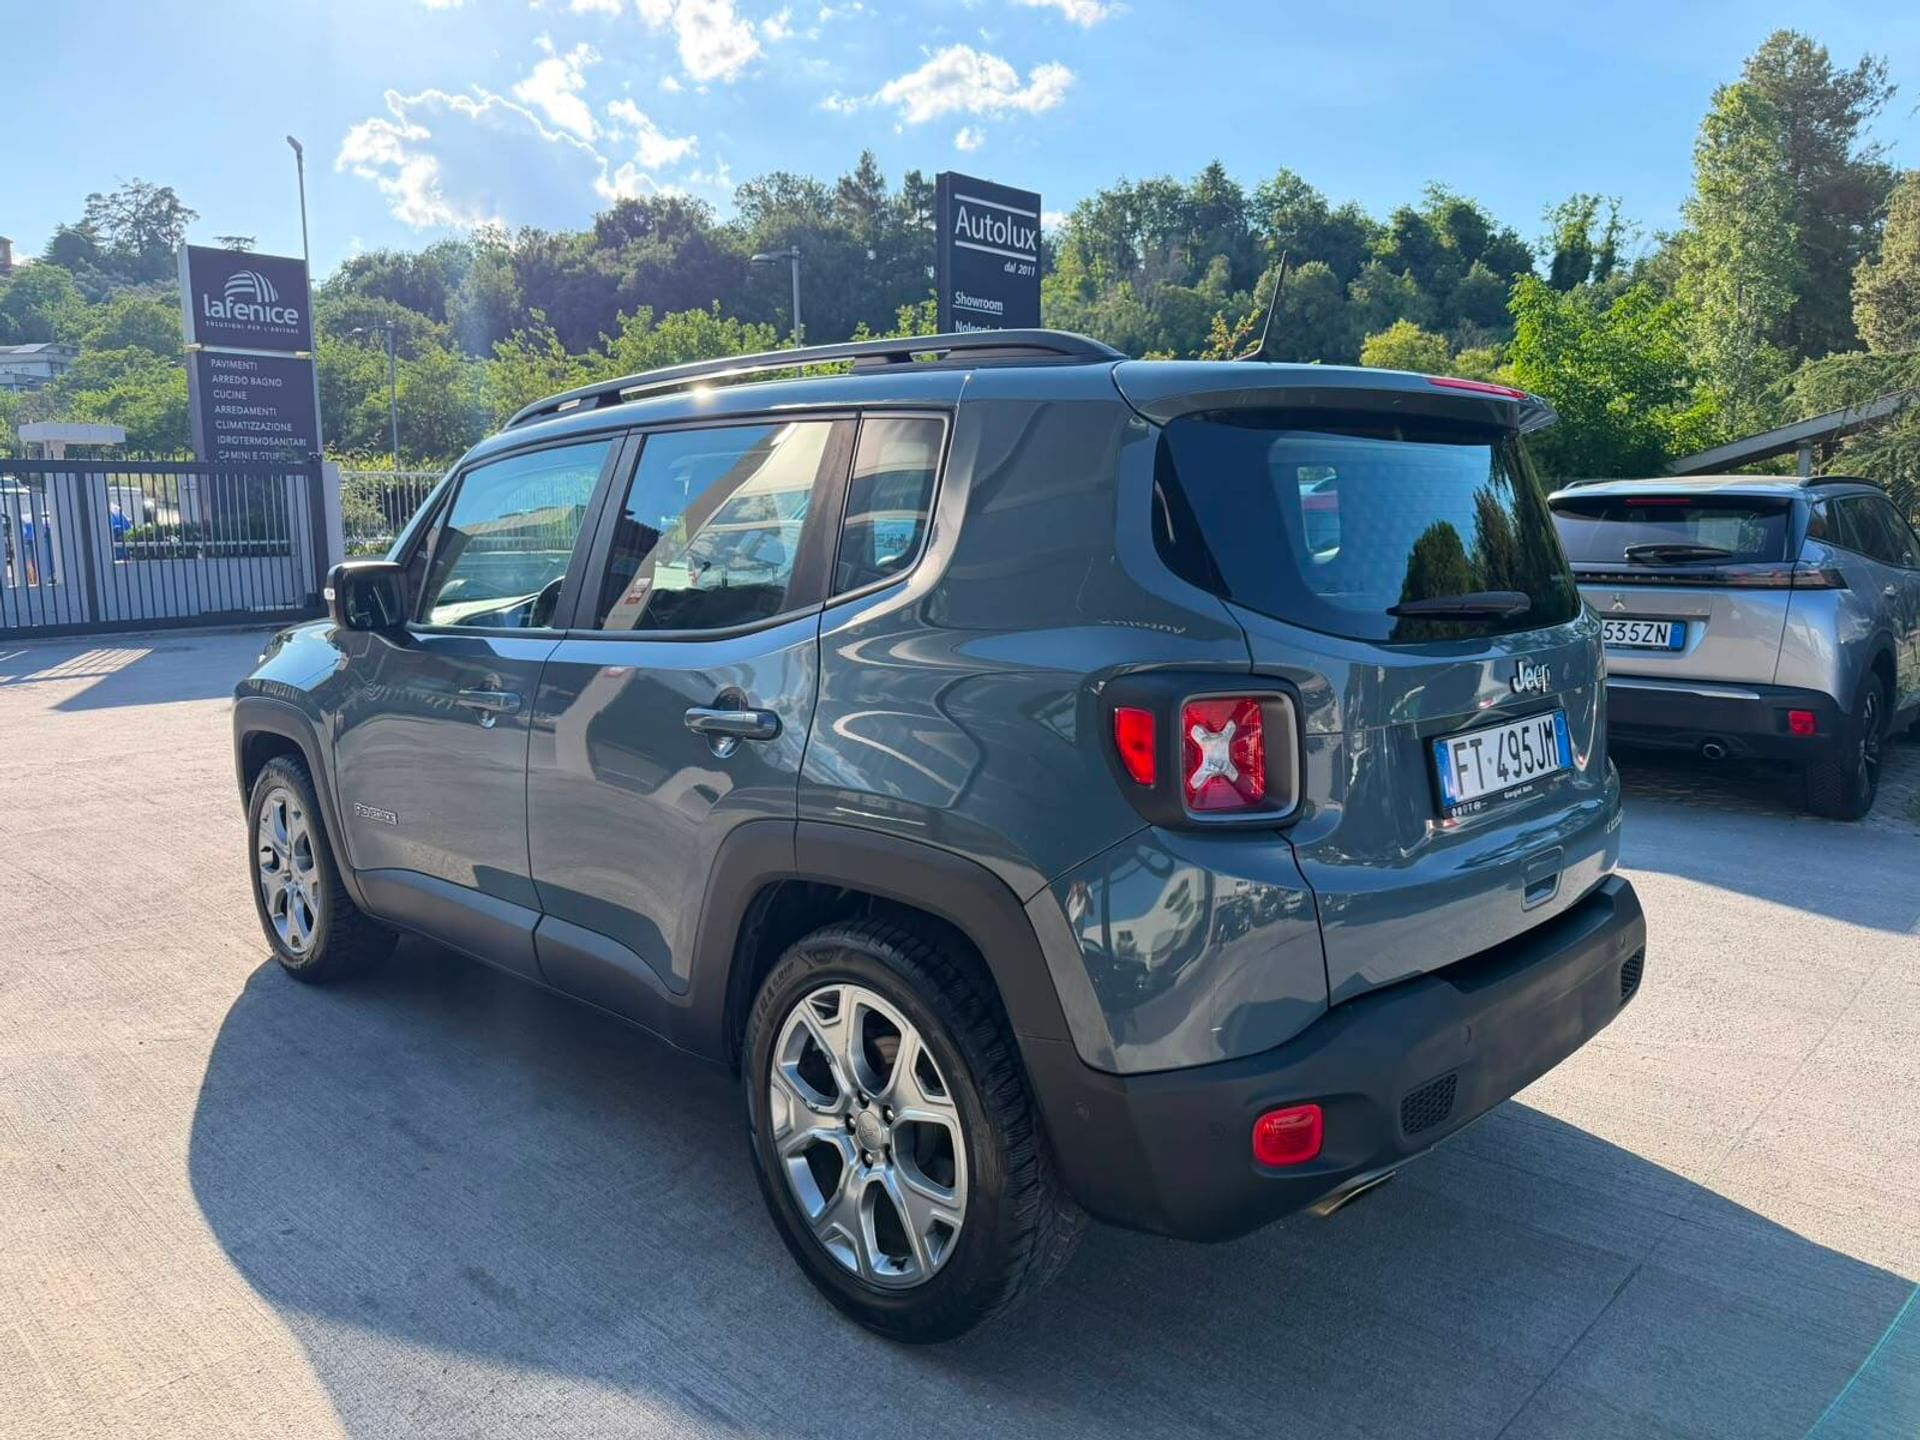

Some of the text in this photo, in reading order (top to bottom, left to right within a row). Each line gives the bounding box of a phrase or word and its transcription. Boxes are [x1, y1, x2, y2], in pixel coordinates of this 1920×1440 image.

[954, 205, 1037, 251] Autolux
[1004, 261, 1036, 277] dal 2011
[203, 293, 299, 325] lafenice
[955, 291, 1003, 312] Showroom
[210, 359, 257, 371] PAVIMENTI
[212, 374, 283, 387] ARREDO BAGNO
[213, 390, 248, 400] CUCINE
[214, 405, 277, 416] ARREDAMENTI
[215, 420, 293, 432] CLIMATIZZAZIONE
[217, 435, 307, 447] IDROTERMOSANITARI
[1603, 621, 1668, 644] 535ZN
[1512, 661, 1551, 693] Jeep
[1452, 719, 1558, 797] FT 495JM
